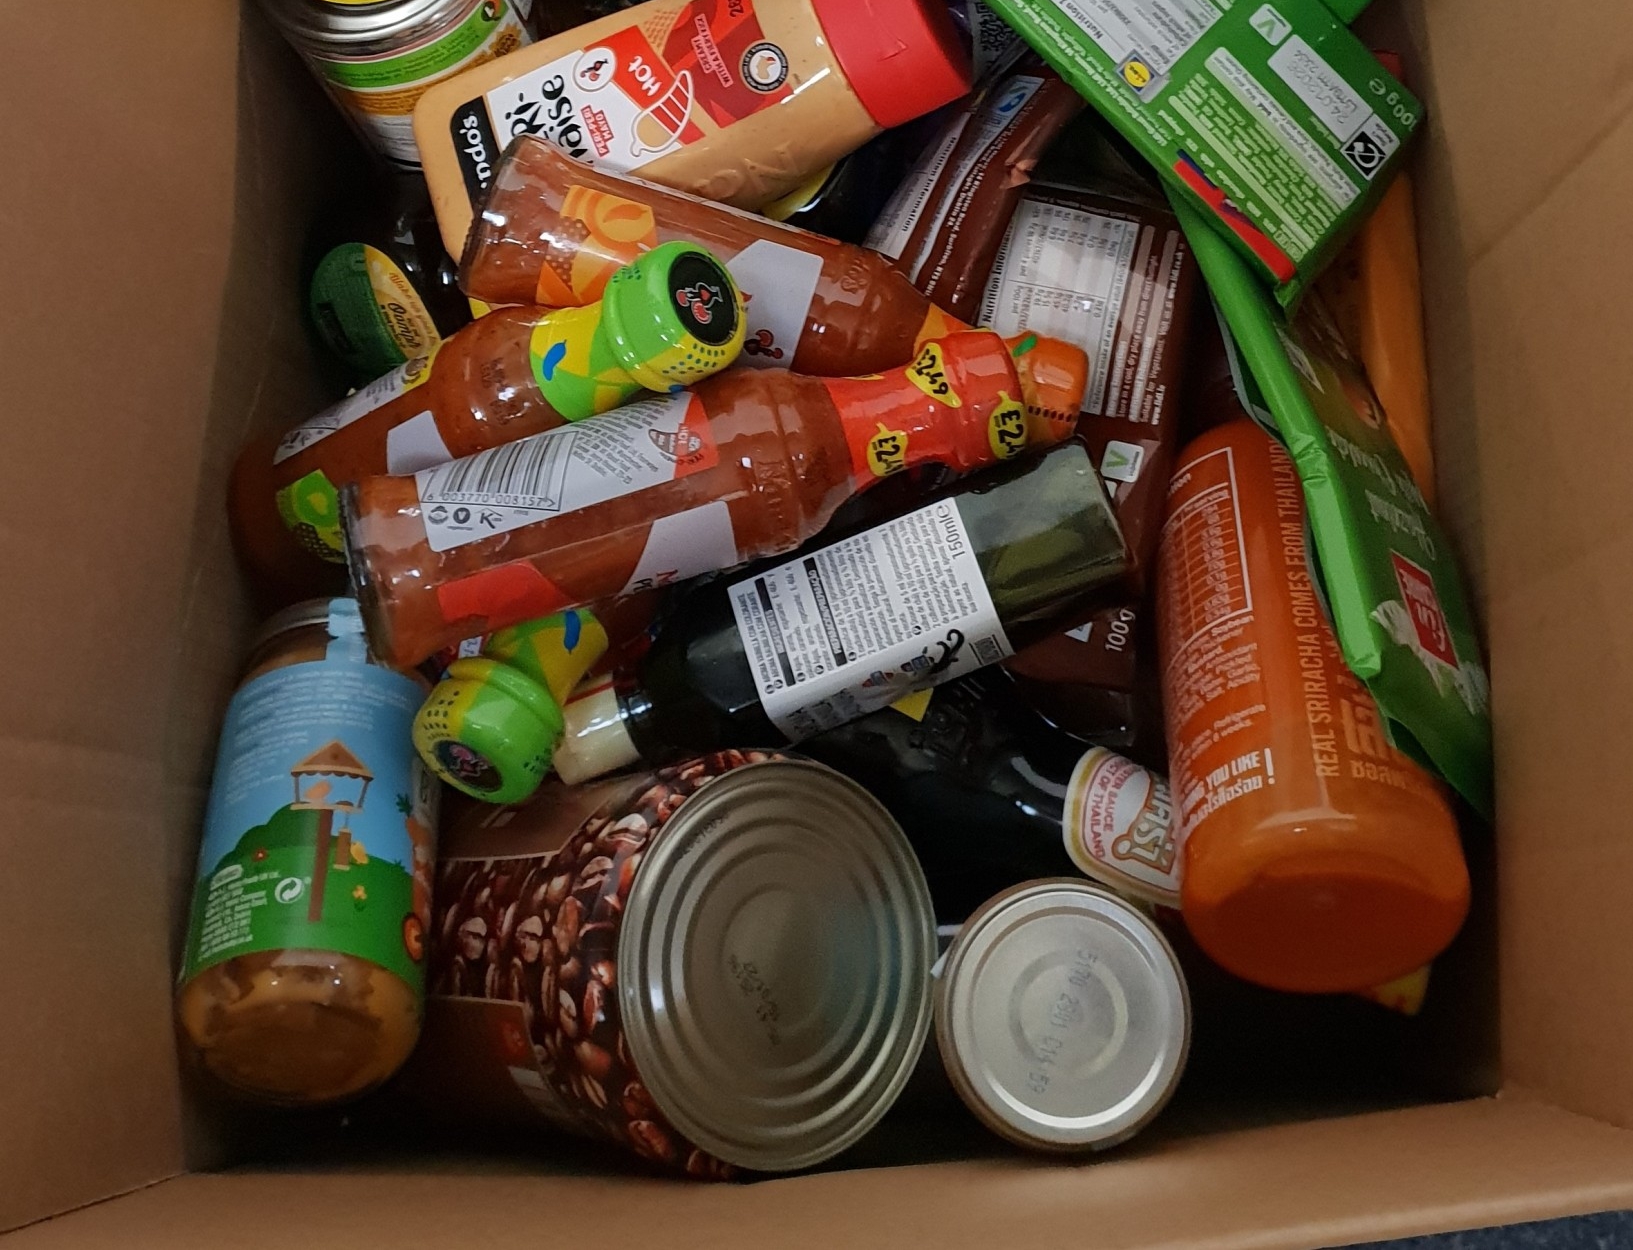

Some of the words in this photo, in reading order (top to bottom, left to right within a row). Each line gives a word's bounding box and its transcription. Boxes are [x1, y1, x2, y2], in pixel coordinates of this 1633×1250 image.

[1063, 0, 1104, 41] Nutrition
[693, 38, 712, 71] CREAMY
[580, 104, 611, 158] PERI-PERI
[595, 109, 615, 141] MAYO
[1386, 92, 1418, 132] 100g
[929, 134, 956, 178] Nutrition
[900, 176, 934, 233] Information
[958, 178, 981, 212] Kingston
[949, 210, 966, 233] Road,
[934, 231, 959, 267] Surbiton,
[979, 276, 1000, 322] Nutrition
[1130, 333, 1141, 352] place
[1134, 316, 1144, 333] away
[911, 347, 949, 396] £2.49
[1124, 366, 1134, 383] cool,
[1127, 353, 1137, 365] dry
[441, 490, 489, 504] 003770
[939, 516, 965, 559] 150ml
[1280, 522, 1306, 565] FROM
[1288, 570, 1317, 627] COMES
[1105, 608, 1135, 650] 100g
[1297, 633, 1333, 723] SRIRACHA
[1204, 761, 1232, 788] YOU
[1231, 749, 1262, 778] LIKE
[1311, 728, 1339, 777] REAL
[1098, 774, 1110, 791] OF
[1093, 794, 1106, 857] THAILAND
[1103, 790, 1119, 831] SAUCE
